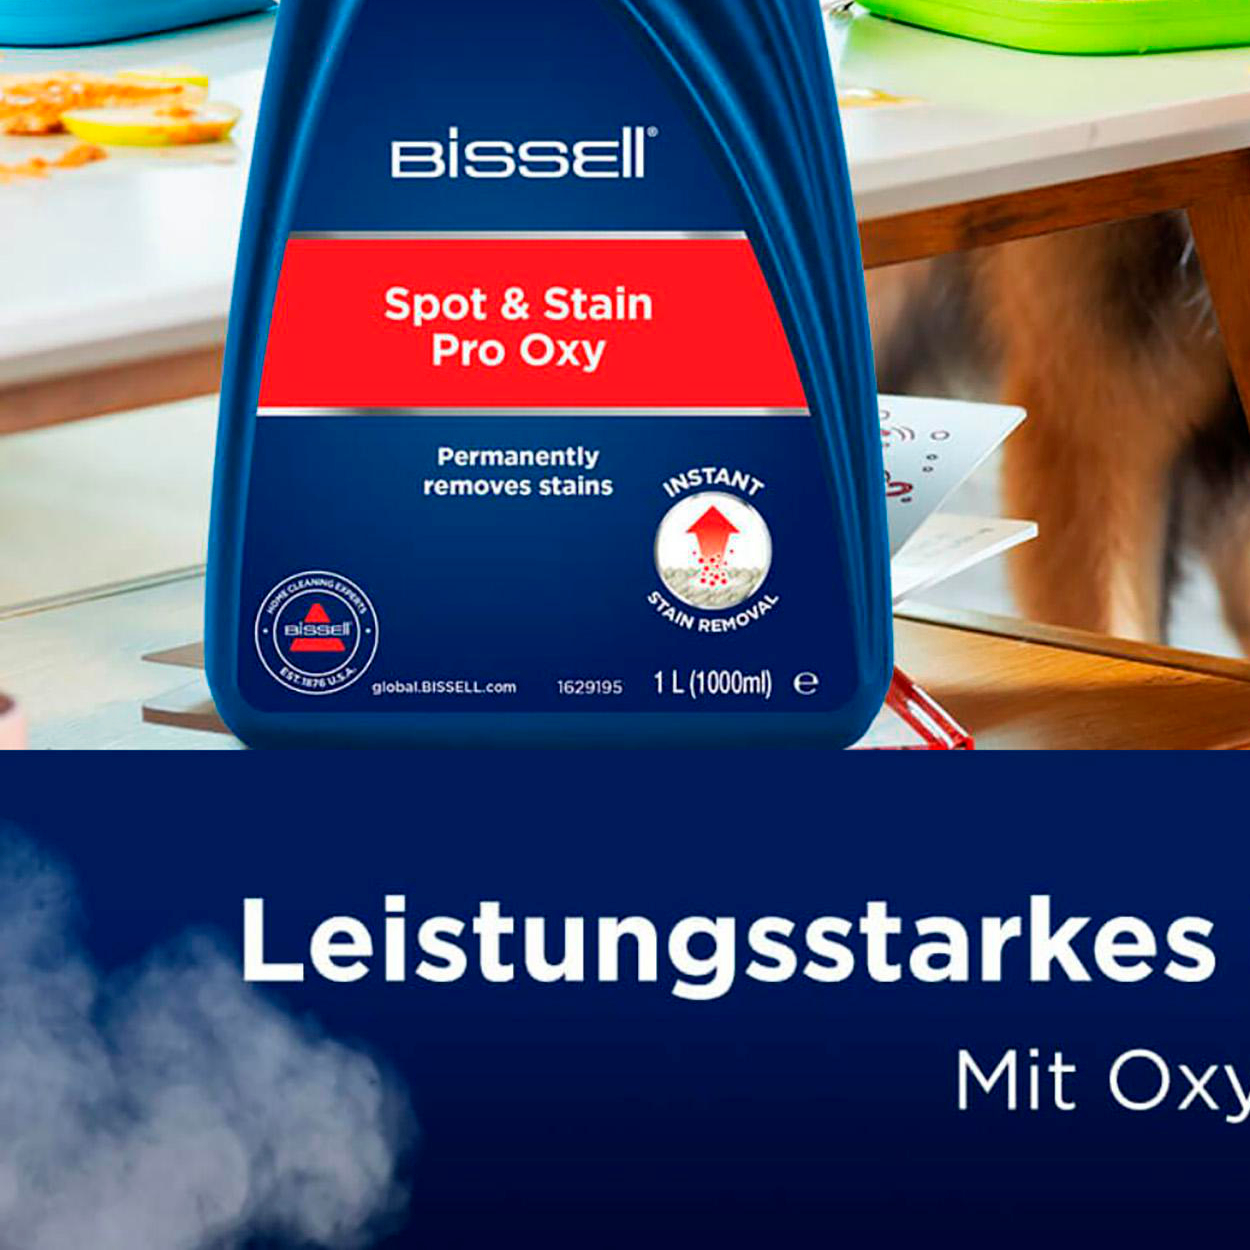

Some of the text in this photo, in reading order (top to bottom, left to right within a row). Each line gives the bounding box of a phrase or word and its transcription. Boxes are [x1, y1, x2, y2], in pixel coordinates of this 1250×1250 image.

[384, 285, 652, 327] Spot & Stain
[432, 333, 607, 373] Pro Oxy
[438, 446, 600, 472] Permanently
[423, 475, 613, 496] removes stains
[662, 467, 765, 498] INSTANT
[267, 578, 367, 614] HOME CLEANING EXPERTS
[647, 591, 779, 632] STAIN REMOVAL
[372, 680, 517, 696] global.BISSELL.com
[557, 680, 623, 695] 1629195
[654, 669, 772, 699] 1 L (1000ml)
